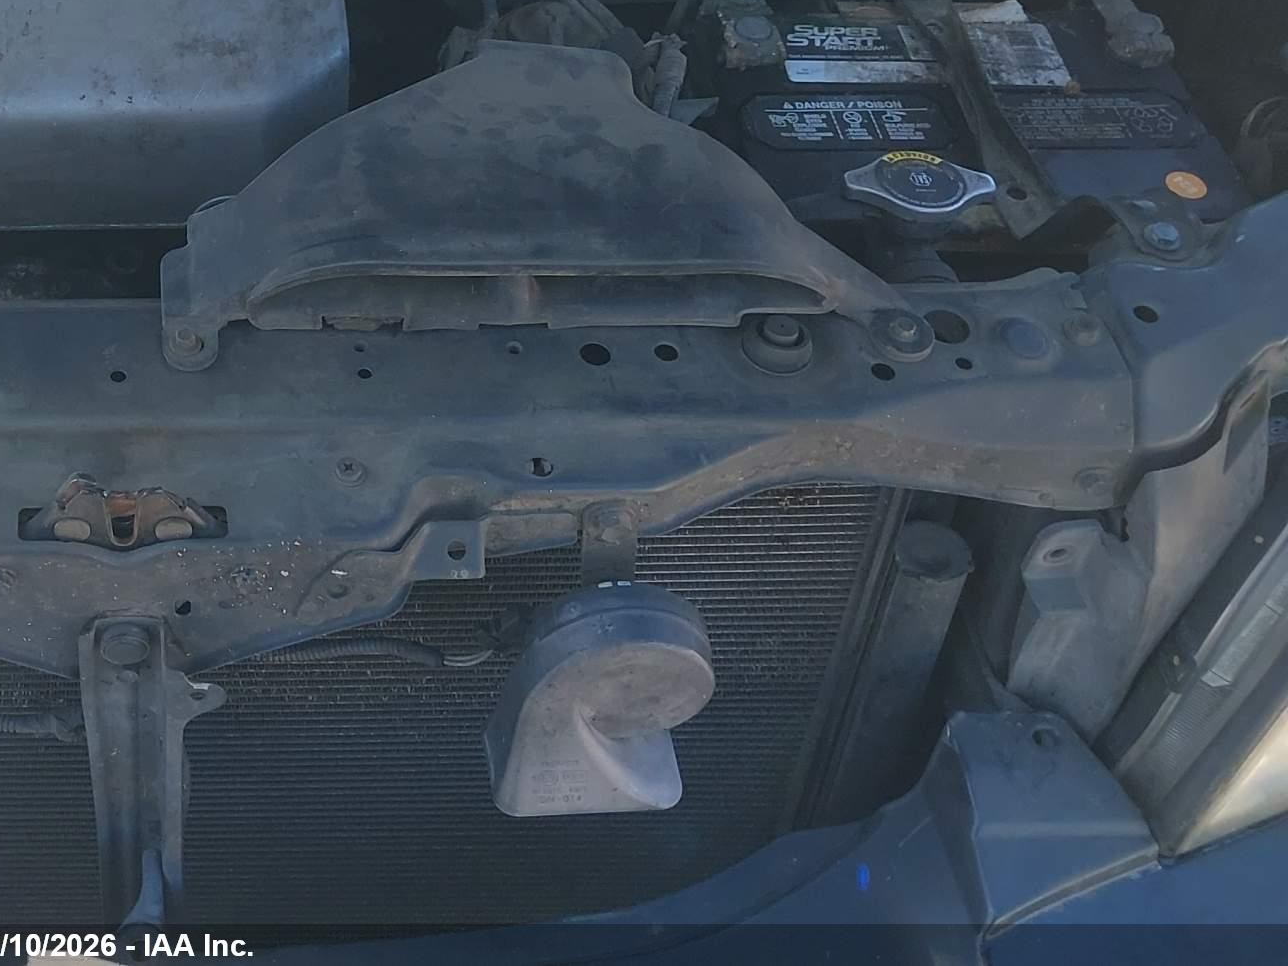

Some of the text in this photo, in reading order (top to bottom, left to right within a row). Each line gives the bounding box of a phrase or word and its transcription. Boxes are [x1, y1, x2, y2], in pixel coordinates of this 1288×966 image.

[793, 24, 880, 37] SUPER
[785, 34, 882, 48] START
[795, 101, 845, 110] DANGER
[856, 99, 903, 109] POISON
